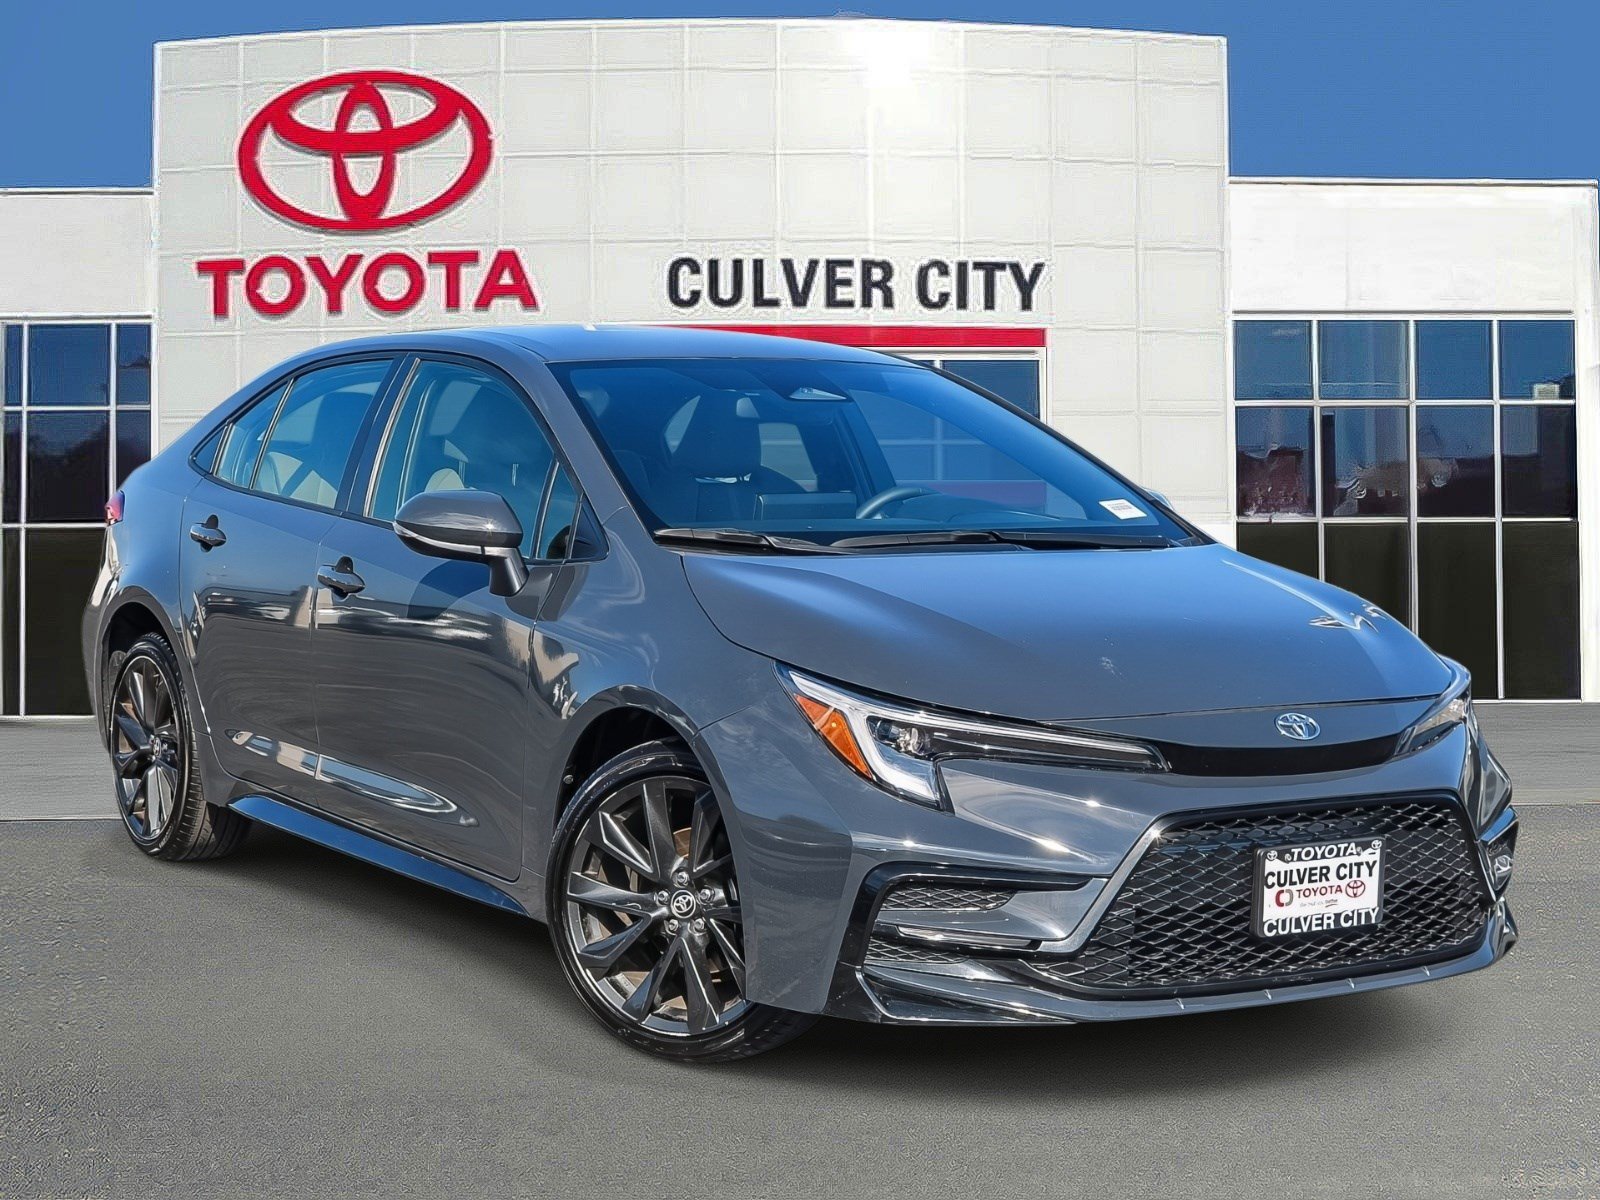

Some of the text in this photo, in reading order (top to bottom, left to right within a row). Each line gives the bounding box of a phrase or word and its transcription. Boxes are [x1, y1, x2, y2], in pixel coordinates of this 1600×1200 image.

[195, 250, 539, 319] TOYOTA
[667, 257, 1045, 311] CULVER CITY
[1290, 842, 1357, 862] TOYOTA
[1264, 860, 1378, 889] CULVER CITY
[1296, 885, 1343, 899] TOYOTA
[1263, 906, 1380, 937] CULVER CITY
